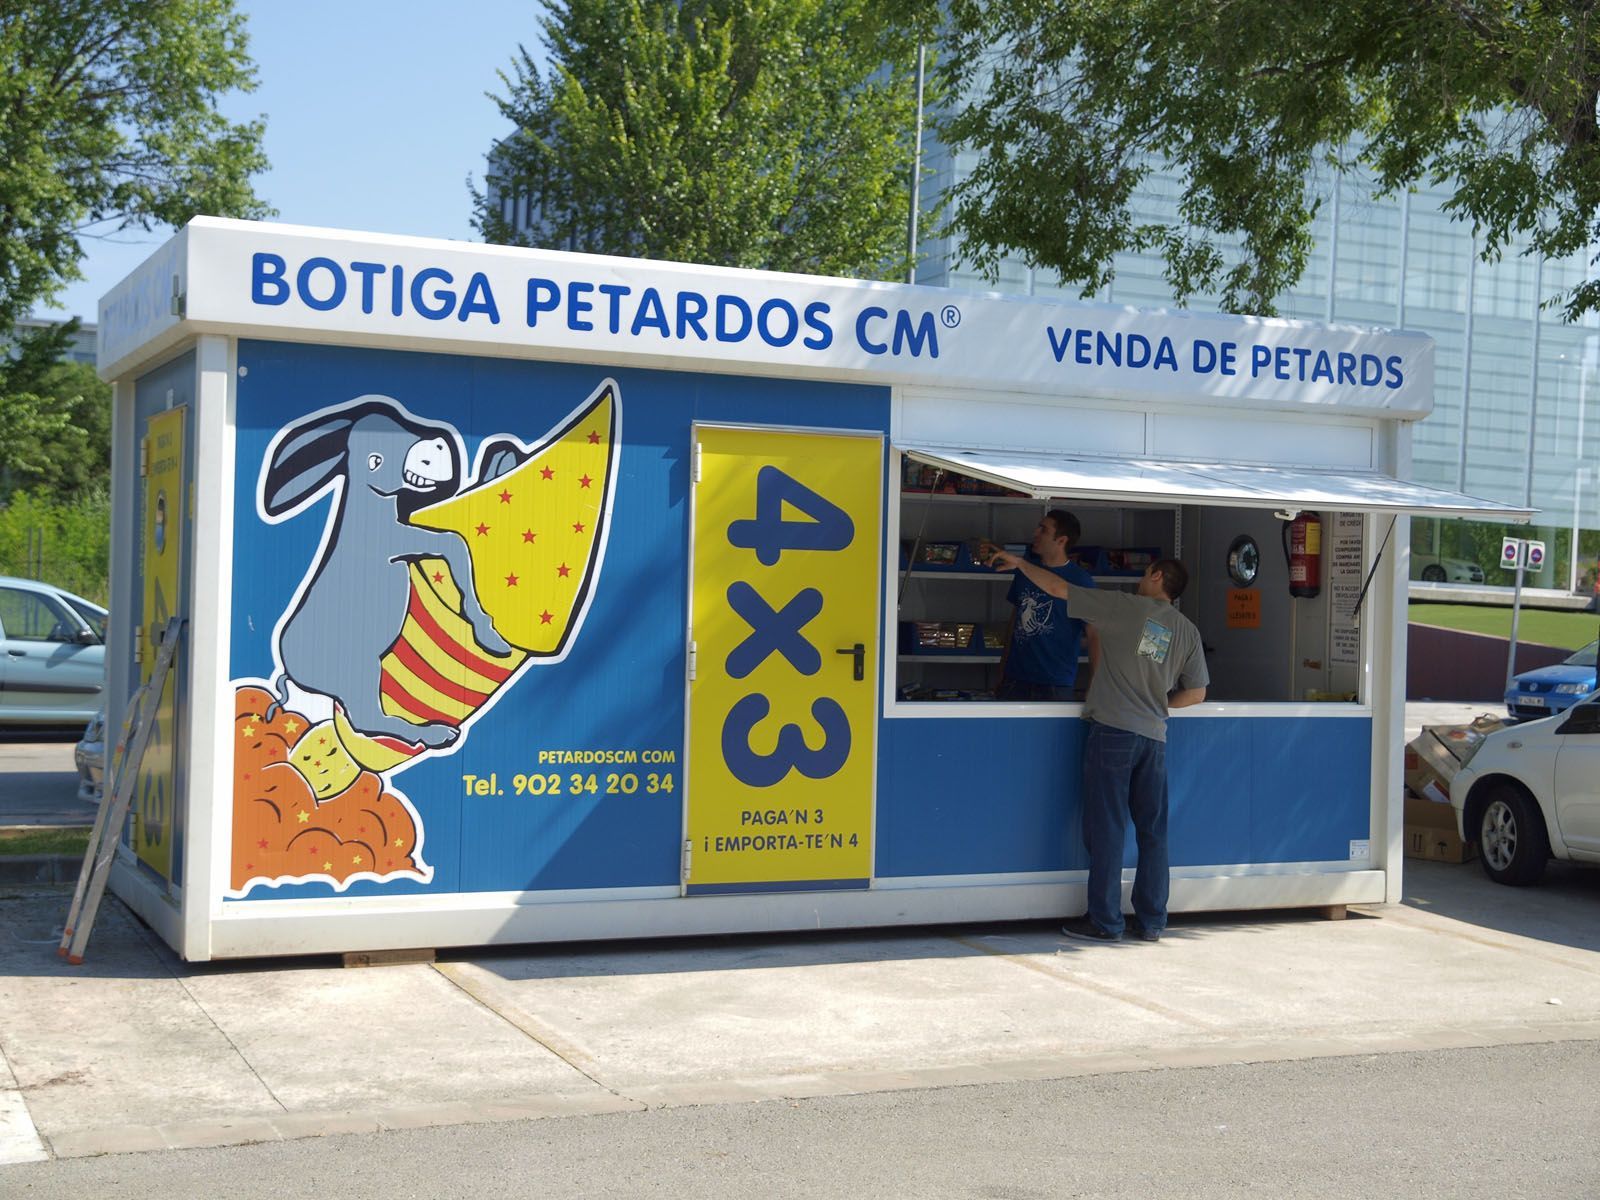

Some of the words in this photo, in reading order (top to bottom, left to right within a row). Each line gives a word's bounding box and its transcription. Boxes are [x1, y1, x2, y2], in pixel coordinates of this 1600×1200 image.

[251, 252, 500, 325] BOTIGA
[527, 278, 833, 350] PETARDOS
[1047, 326, 1178, 371] VENDA
[1193, 339, 1237, 375] DE
[1252, 344, 1404, 389] PETARDS
[539, 750, 637, 764] PETARDOSCM
[641, 750, 676, 764] COM
[462, 773, 504, 796] Tel.
[512, 774, 562, 796] 902
[569, 773, 598, 795] 34
[606, 773, 639, 794] 20
[646, 773, 674, 794] 34
[814, 809, 824, 824] 3
[848, 833, 859, 848] 4
